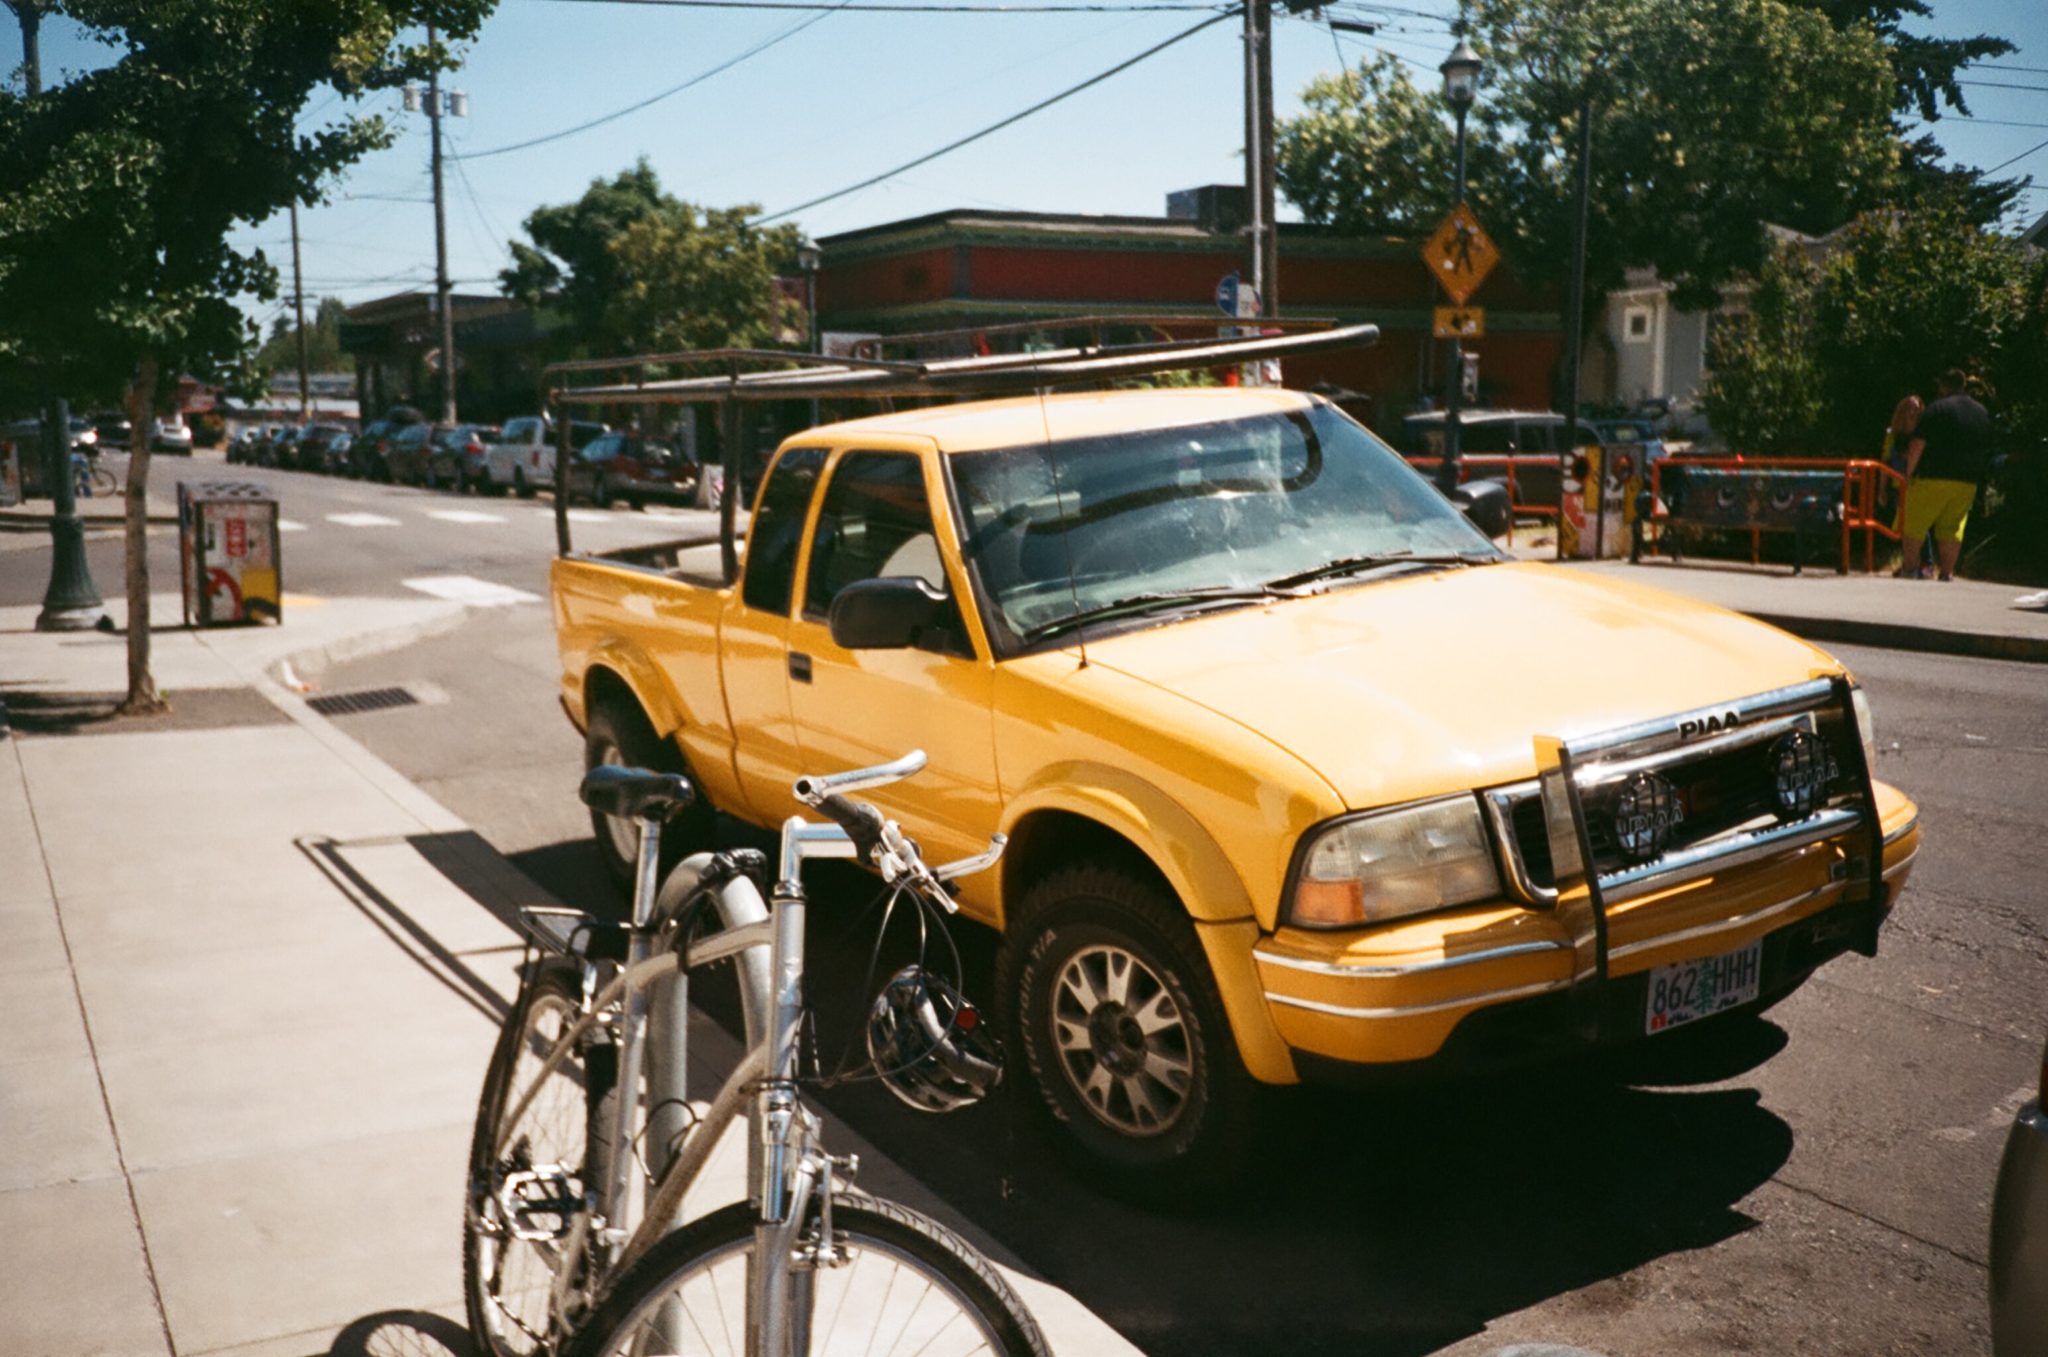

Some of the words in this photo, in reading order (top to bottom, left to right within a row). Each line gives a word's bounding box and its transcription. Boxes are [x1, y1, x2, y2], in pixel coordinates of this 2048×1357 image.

[1679, 711, 1740, 740] PIAA
[1790, 761, 1840, 790] PIAA
[1628, 805, 1684, 834] PIAA
[1653, 966, 1698, 1014] 862
[1712, 946, 1758, 998] HHH
